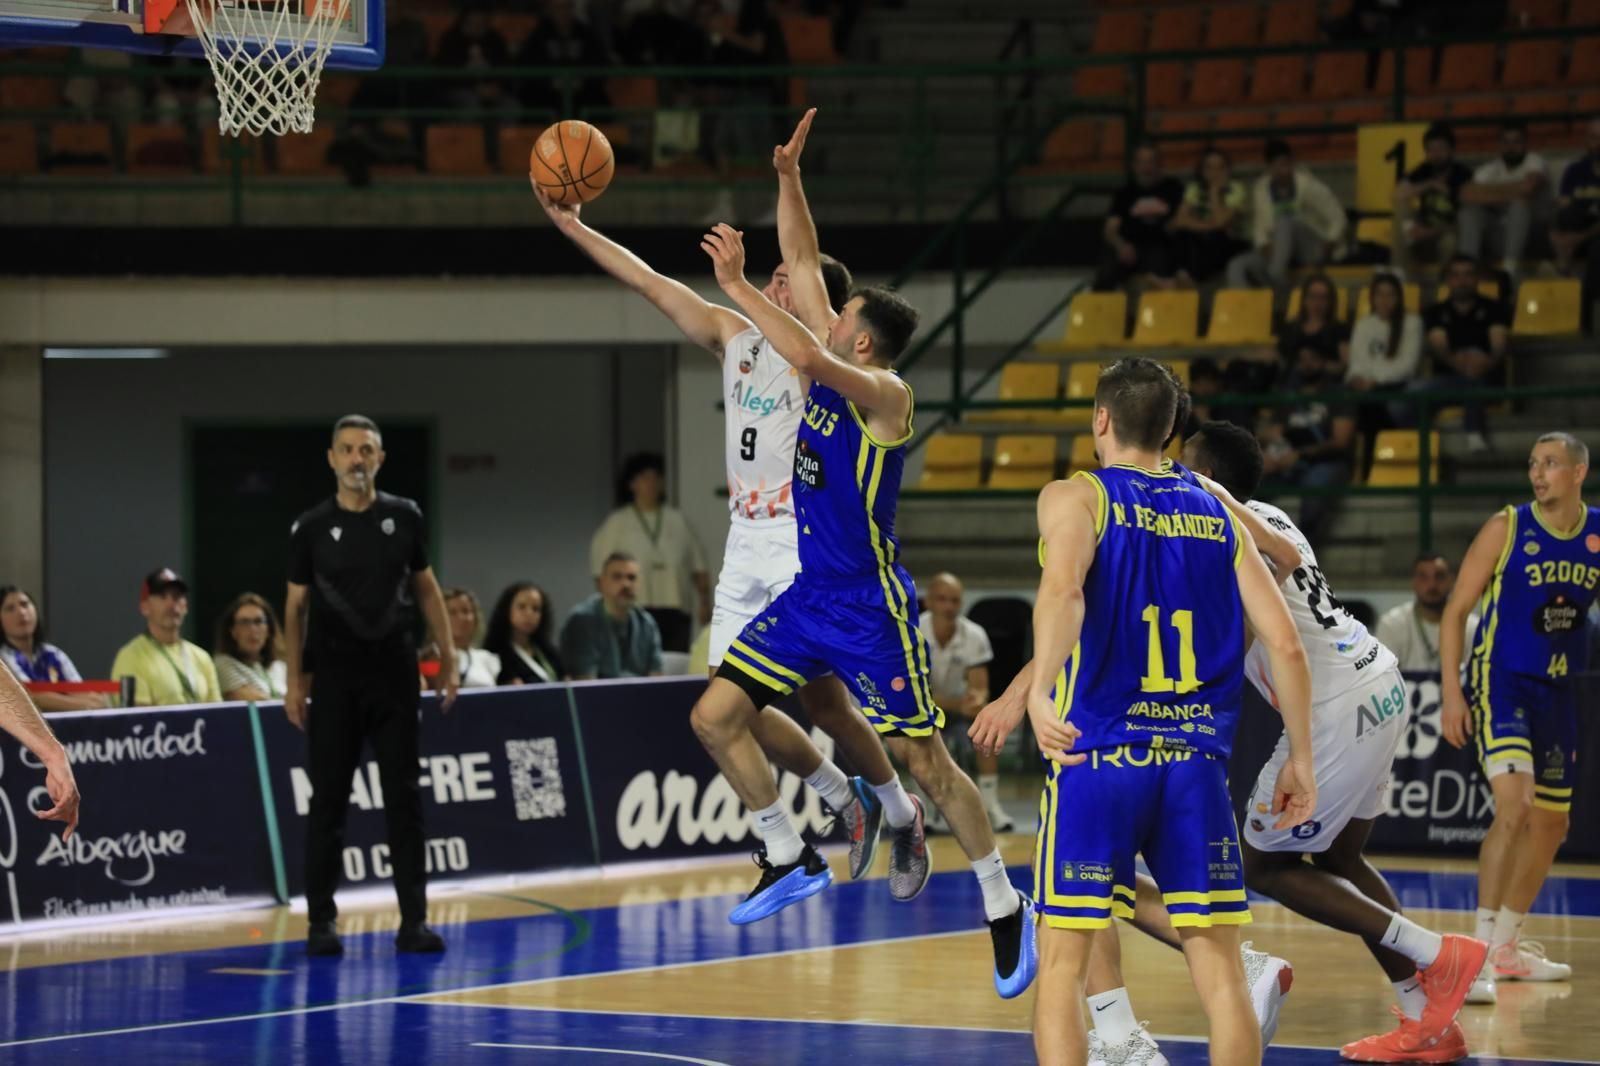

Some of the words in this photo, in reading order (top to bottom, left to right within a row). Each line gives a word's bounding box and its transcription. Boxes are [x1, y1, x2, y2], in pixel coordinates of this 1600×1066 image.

[1384, 140, 1406, 180] 1
[740, 427, 757, 461] 9
[1112, 502, 1132, 528] N.
[1133, 503, 1226, 543] FENÁNDEZ
[1525, 560, 1600, 590] 32005
[1140, 603, 1205, 694] 11
[1546, 652, 1568, 679] 44
[1127, 701, 1214, 720] ABANCA
[1355, 683, 1406, 738] Aleg
[19, 718, 206, 769] Cmunidad
[36, 829, 187, 887] Albergue
